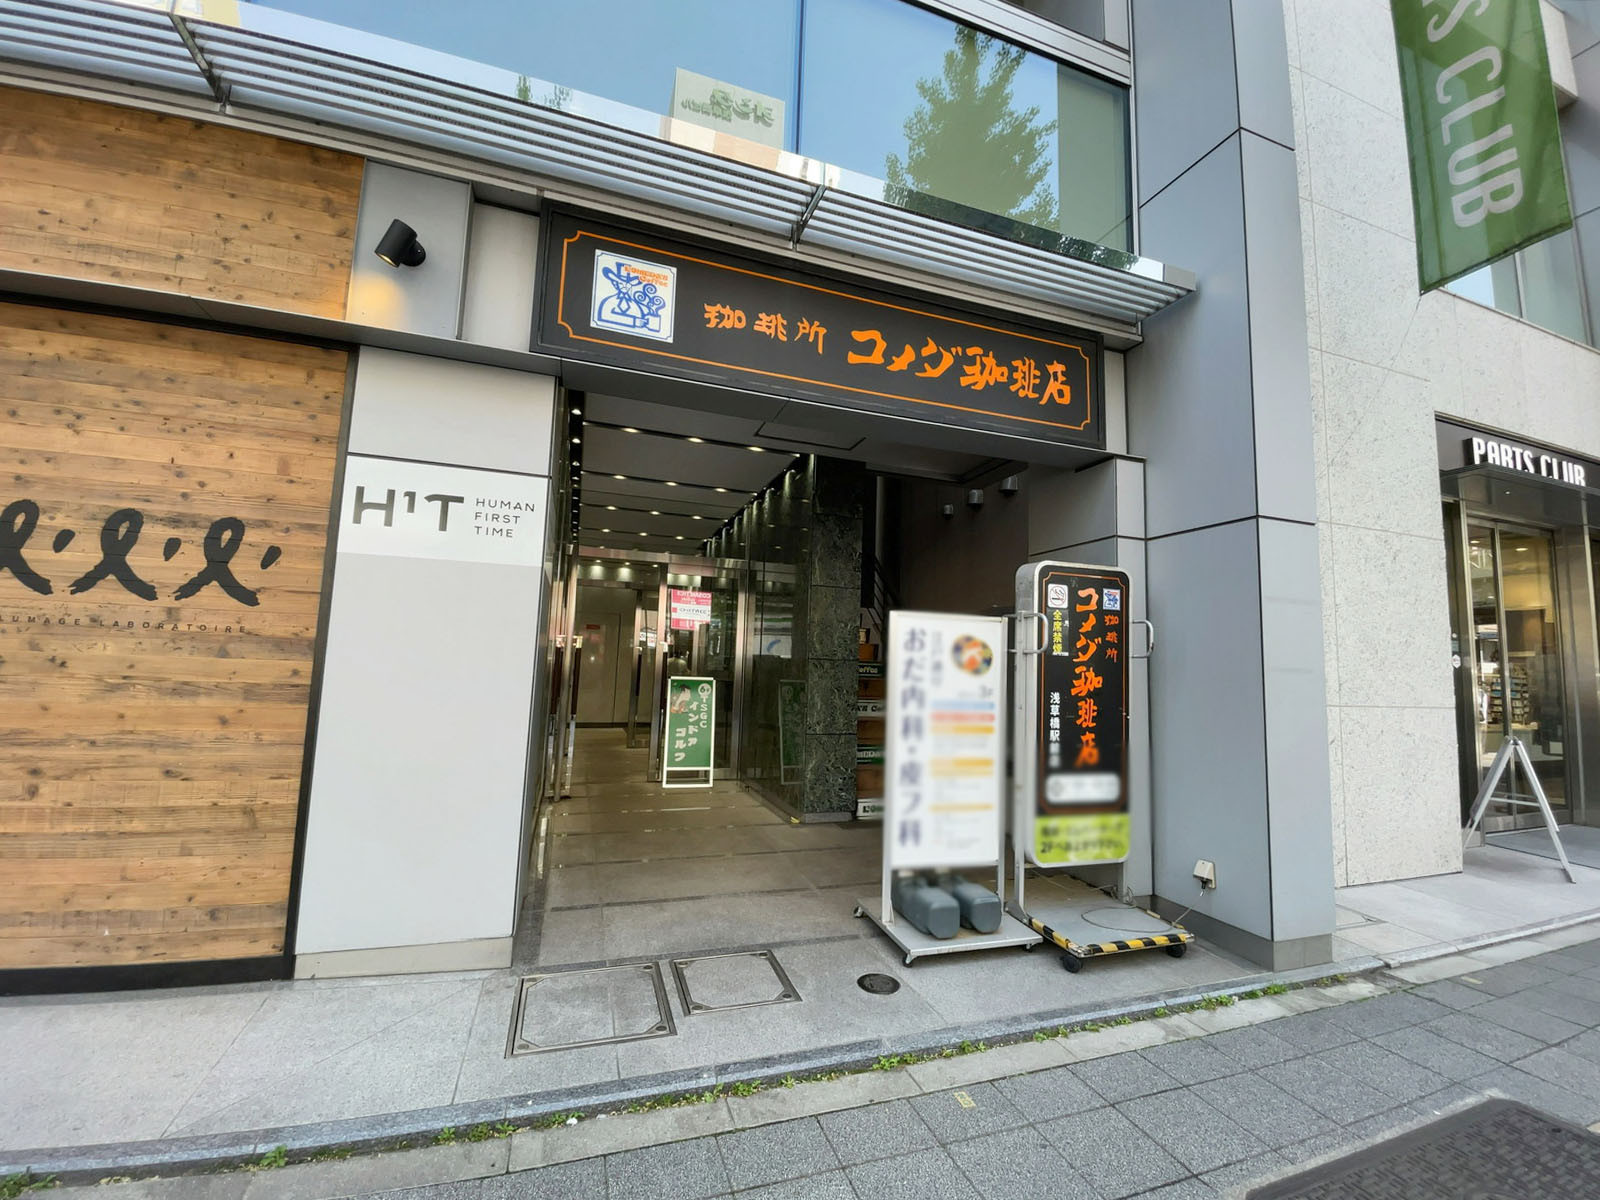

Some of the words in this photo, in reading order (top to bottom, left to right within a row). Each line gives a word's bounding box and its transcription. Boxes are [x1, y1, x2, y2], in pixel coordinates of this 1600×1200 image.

[1436, 46, 1524, 228] CLUB
[847, 329, 1071, 405] コメダ珈琲店
[1472, 437, 1535, 474] PARTS
[1540, 455, 1586, 487] CLUB
[474, 512, 521, 525] FIRST
[476, 498, 536, 513] HUMAN
[474, 526, 514, 538] TIME
[99, 619, 246, 633] LABORATOIRE
[1071, 587, 1103, 768] コメダ珈琲店
[687, 701, 700, 747] インドア
[1050, 691, 1061, 768] 浅草橋駅
